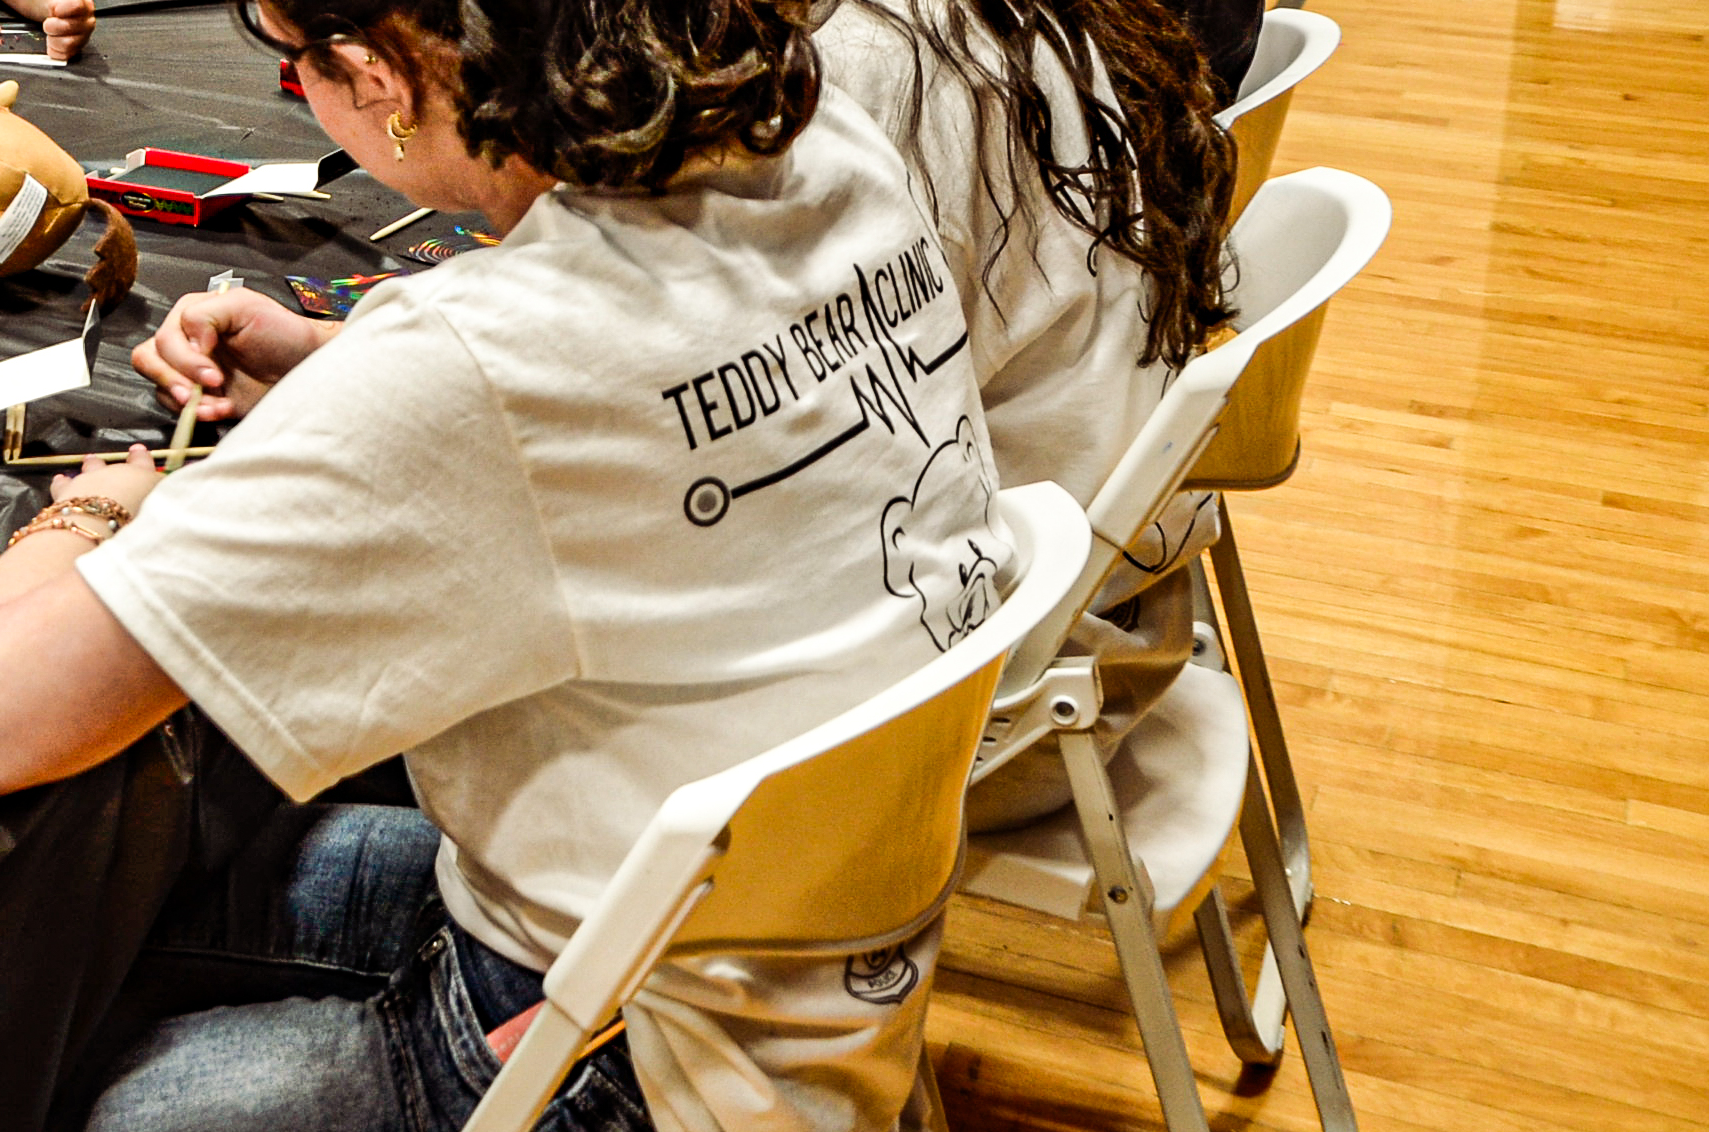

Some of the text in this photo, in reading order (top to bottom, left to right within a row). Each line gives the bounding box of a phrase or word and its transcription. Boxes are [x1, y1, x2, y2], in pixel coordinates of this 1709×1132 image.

[661, 236, 944, 450] TEDDY BEAR CLINIC
